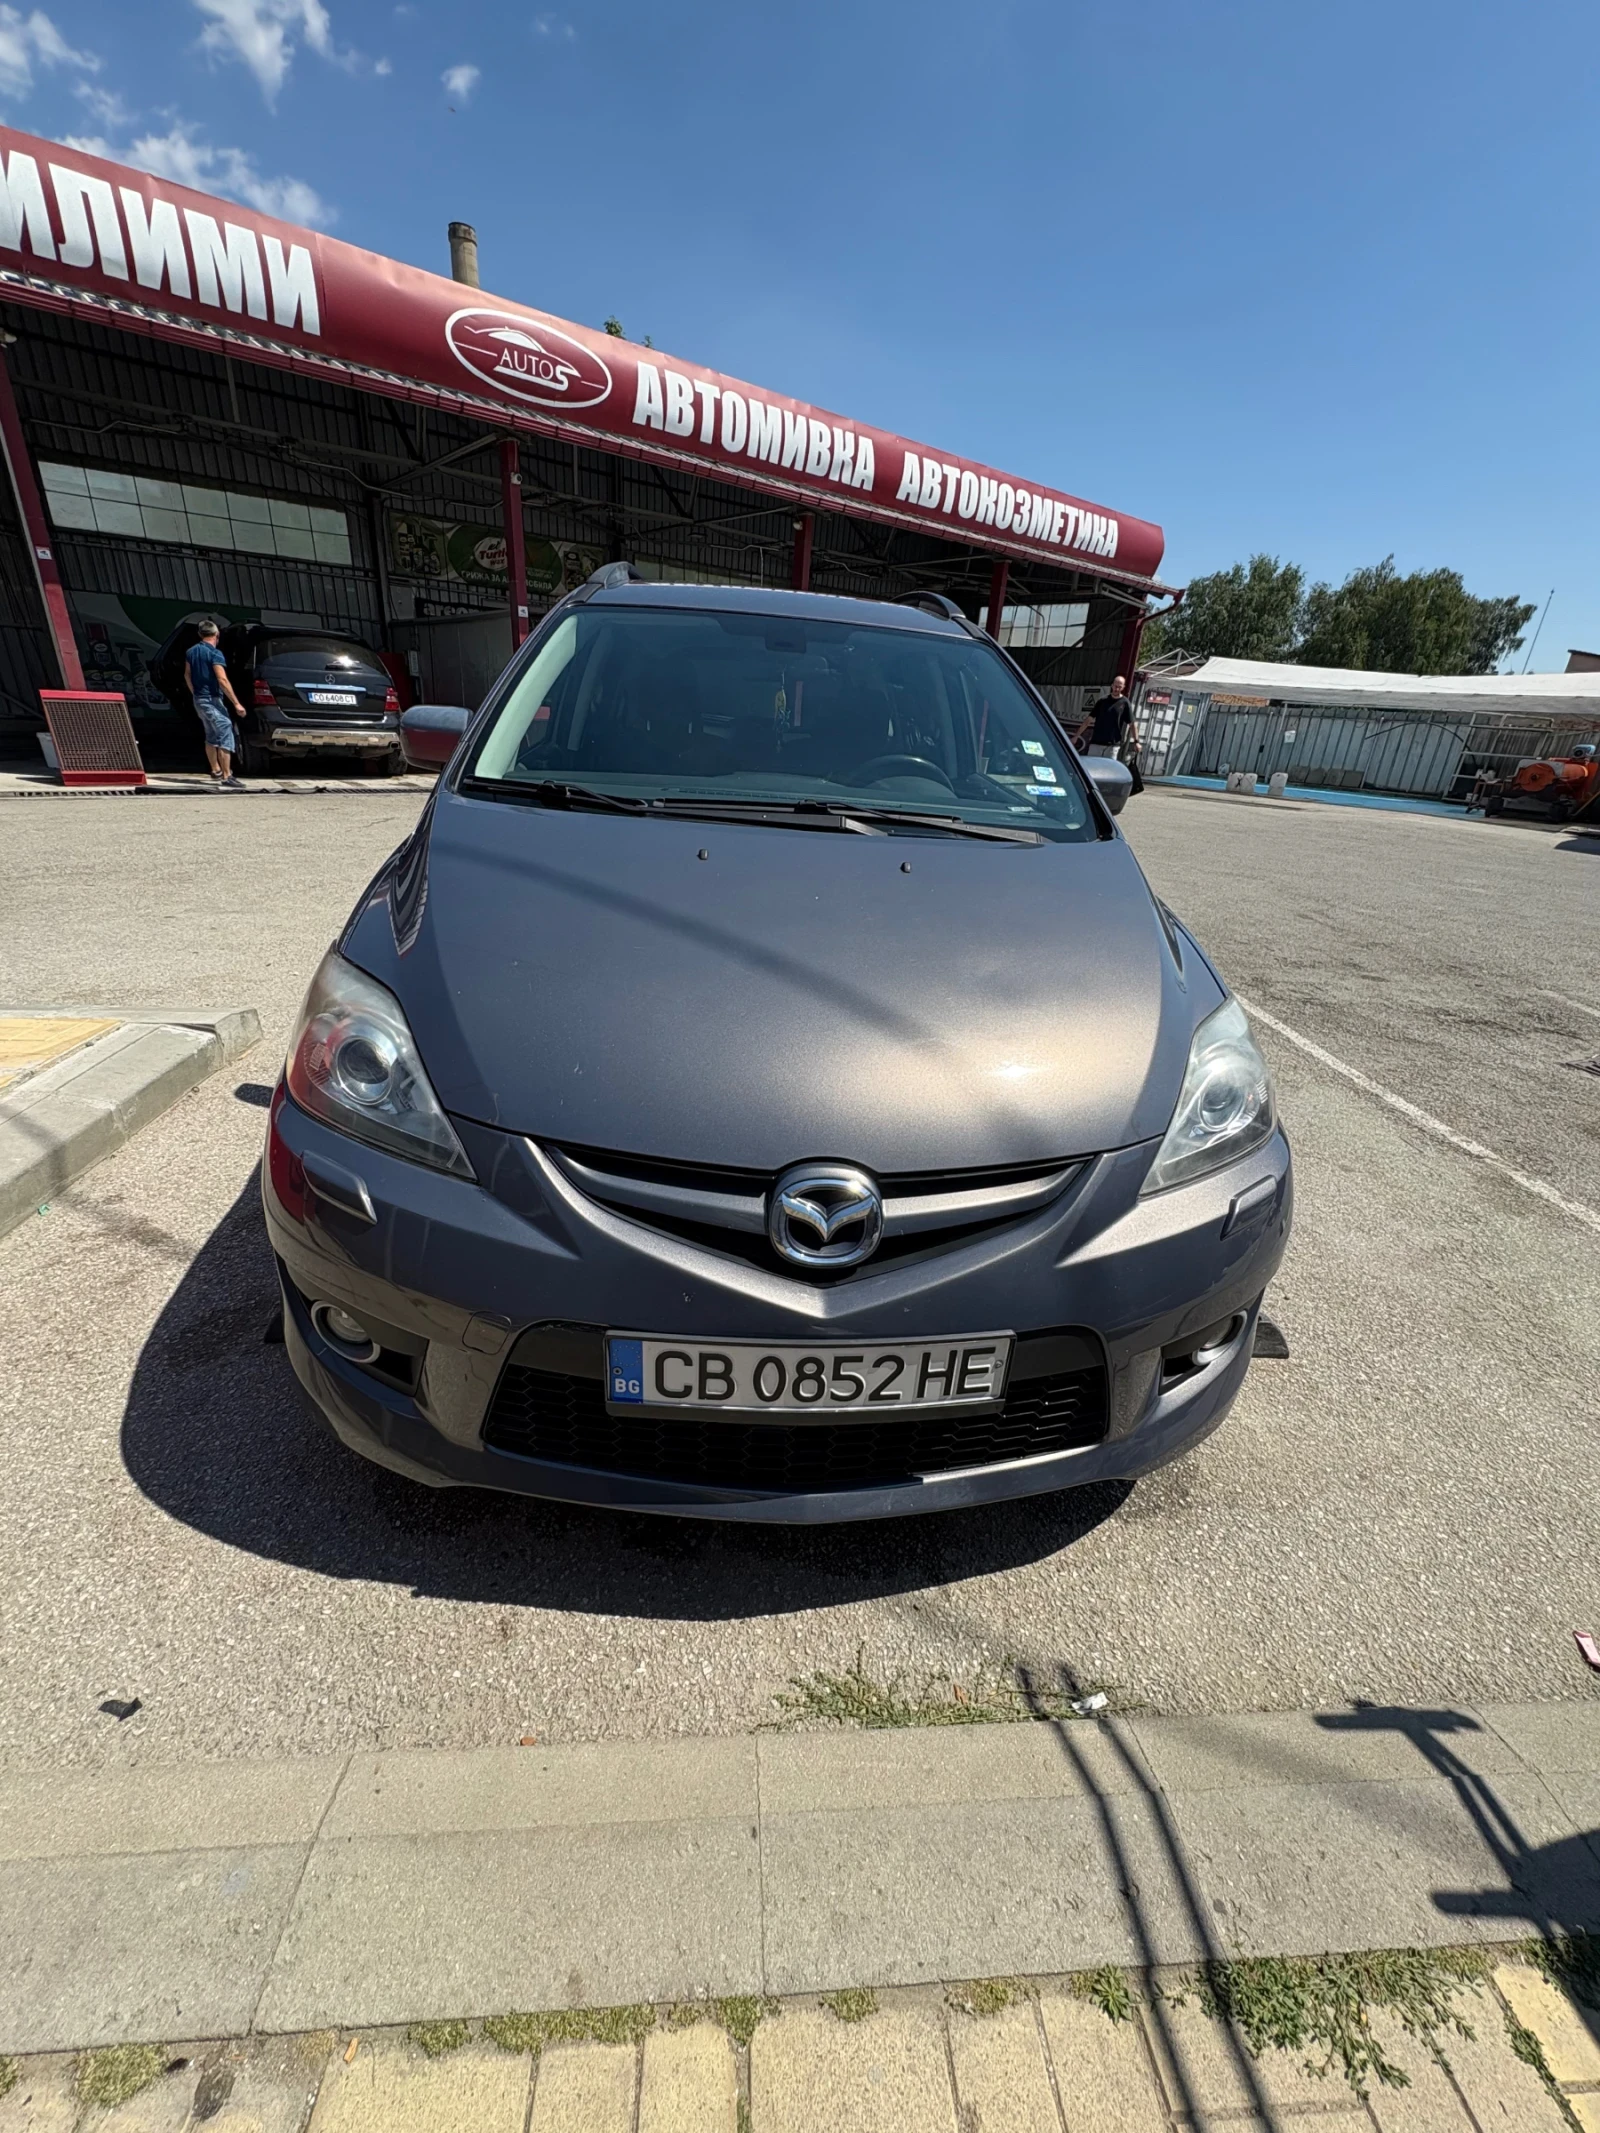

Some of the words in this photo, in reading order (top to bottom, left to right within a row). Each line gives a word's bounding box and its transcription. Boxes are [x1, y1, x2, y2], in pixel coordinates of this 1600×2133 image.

[494, 347, 581, 391] AUTOS
[632, 360, 875, 492] АВТОМИВКА
[895, 451, 1119, 559] АВТОКОЗМЕТИКА
[614, 1378, 640, 1394] BG
[654, 1350, 736, 1400] CB
[753, 1354, 904, 1403] 0852
[916, 1346, 997, 1399] HE
